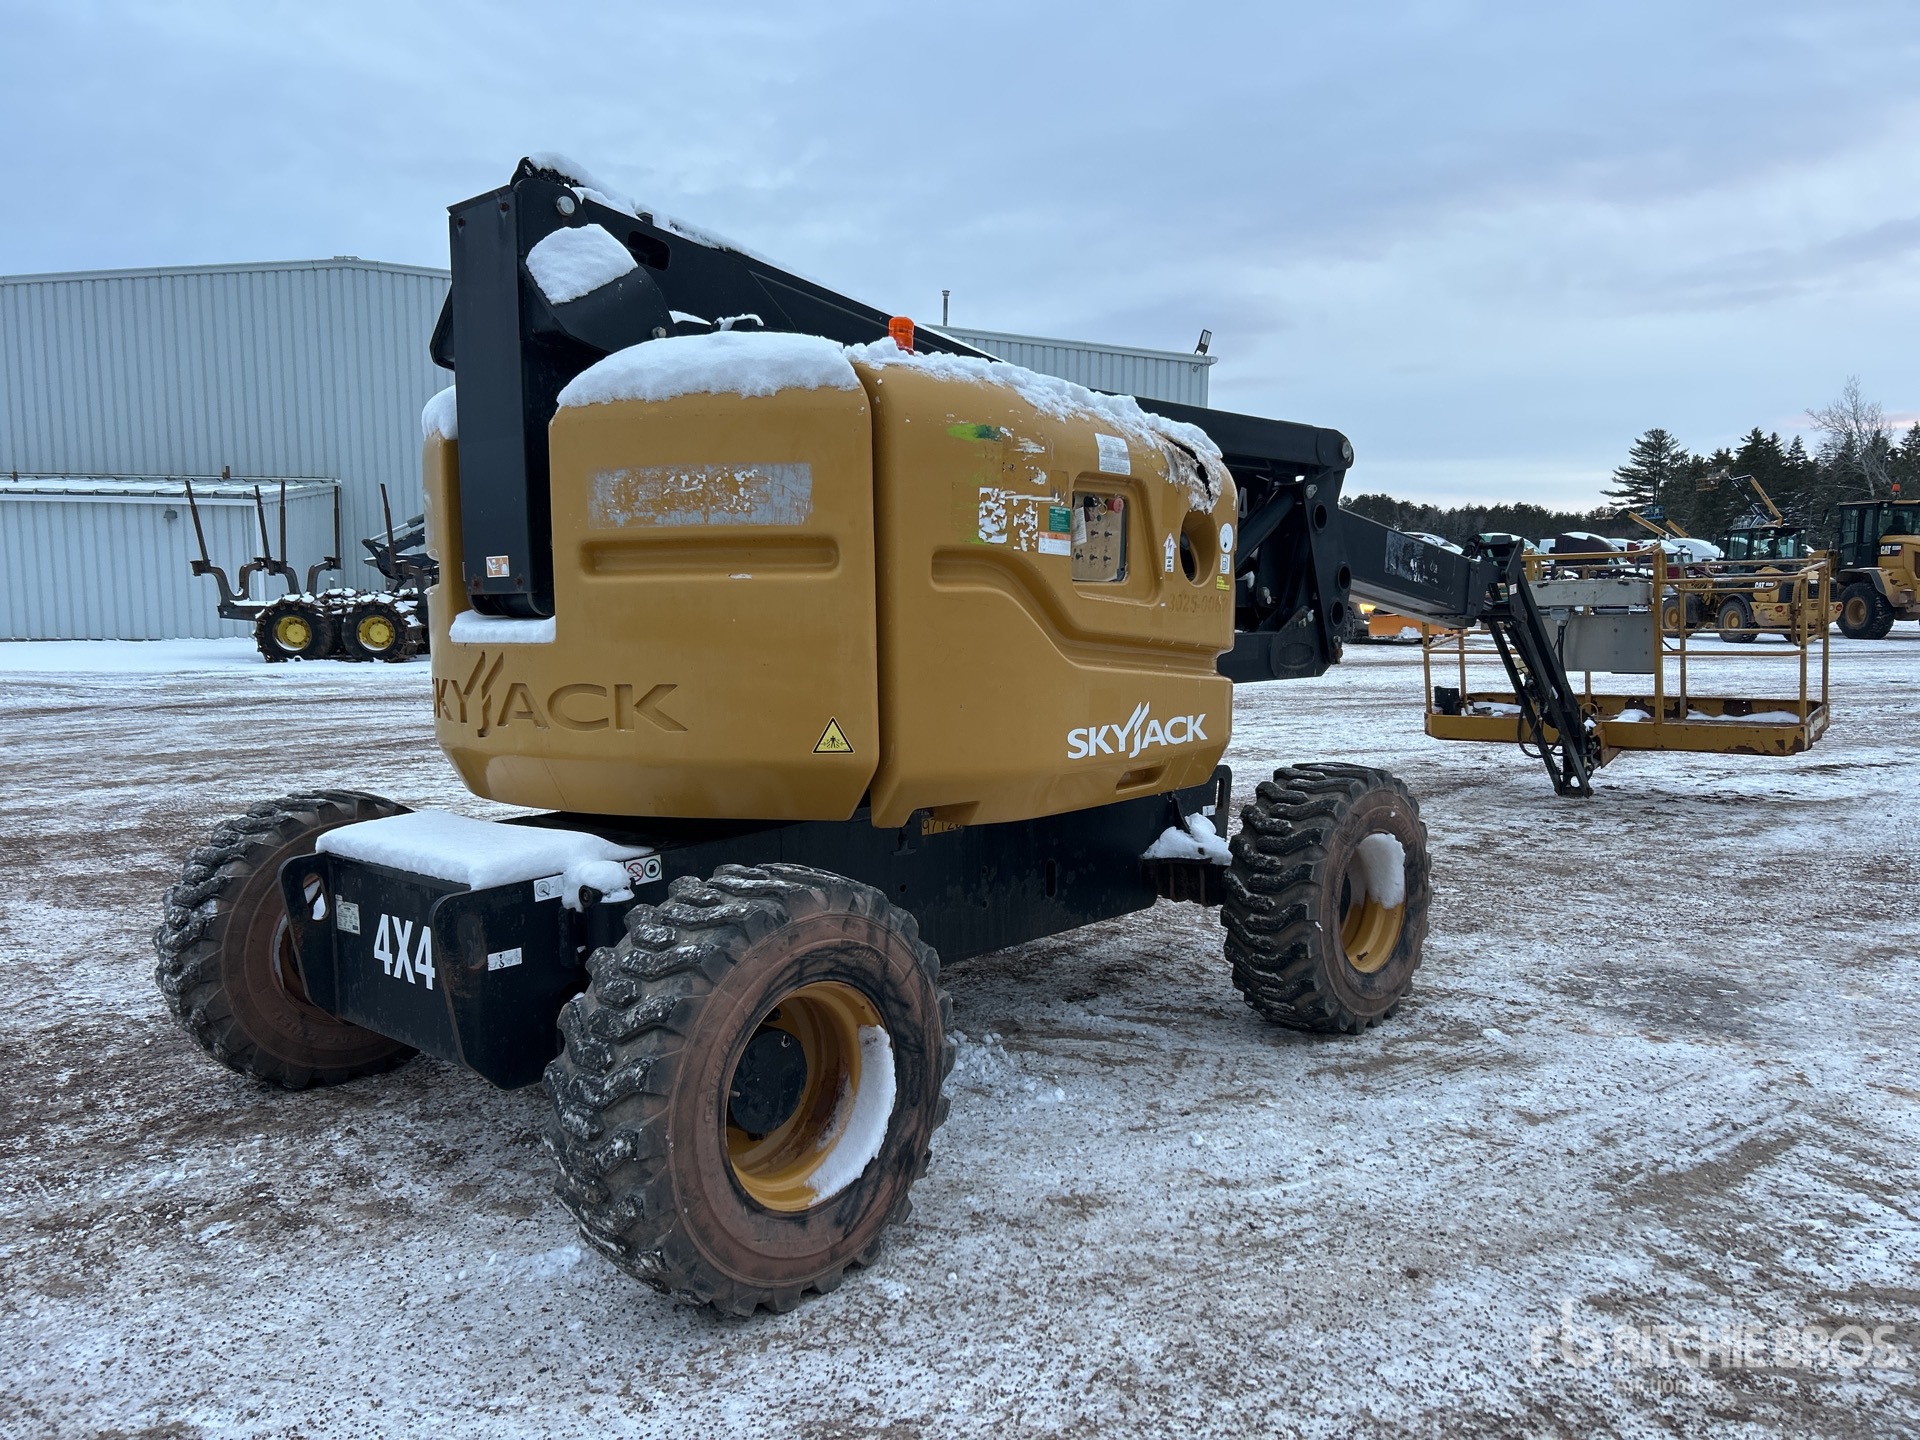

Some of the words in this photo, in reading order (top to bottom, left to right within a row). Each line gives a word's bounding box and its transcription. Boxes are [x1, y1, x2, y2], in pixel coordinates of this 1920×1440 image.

[432, 650, 688, 738] KYJACK
[1067, 701, 1208, 759] SKYJACK
[373, 913, 436, 990] 4X4
